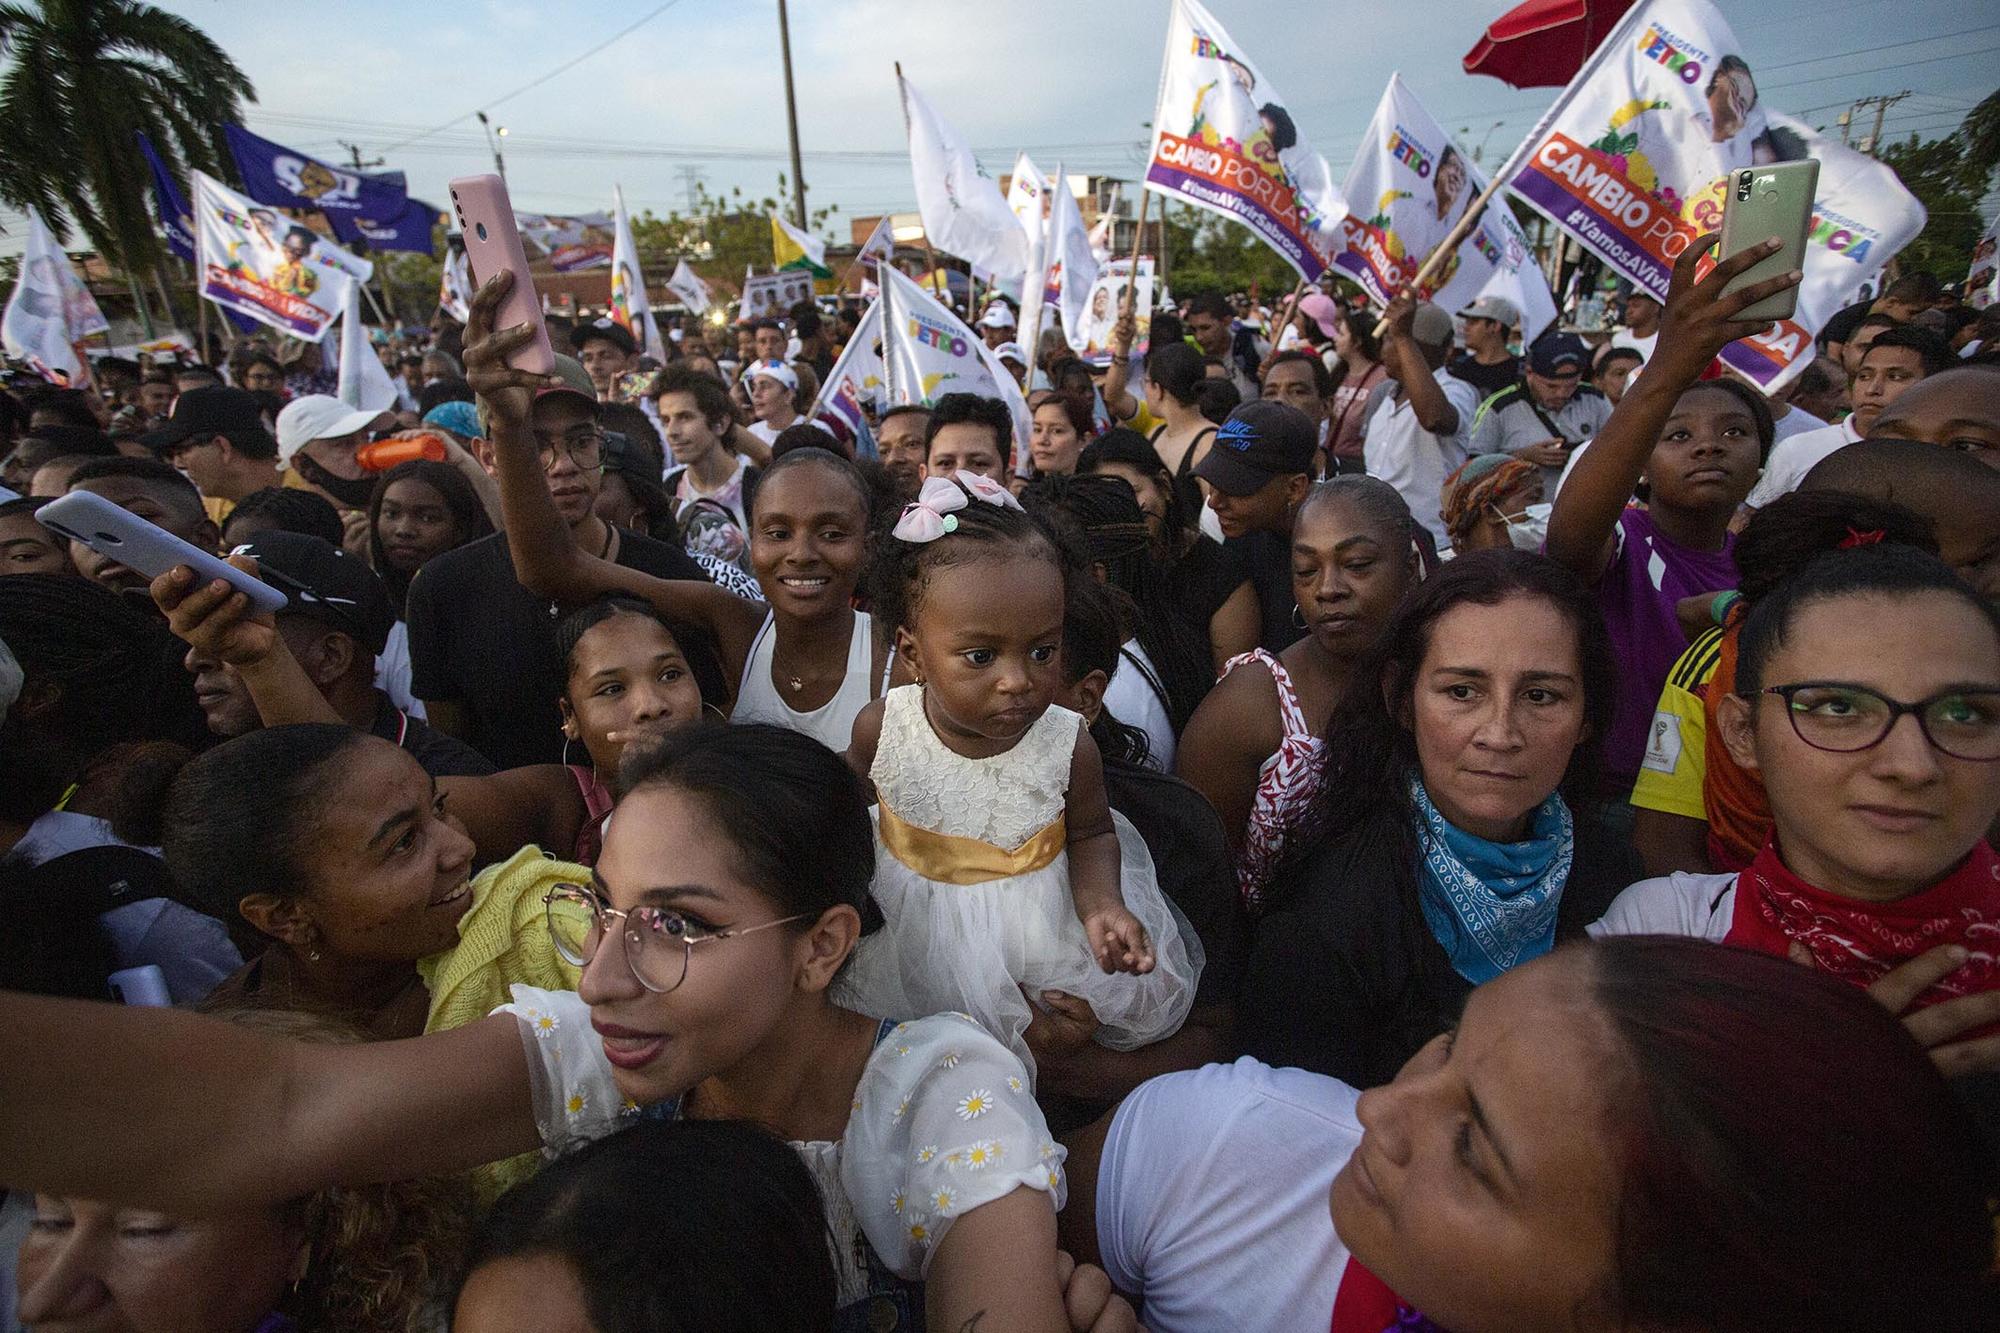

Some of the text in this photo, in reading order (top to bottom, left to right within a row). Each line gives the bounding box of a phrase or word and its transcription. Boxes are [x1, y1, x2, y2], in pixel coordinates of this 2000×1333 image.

[1638, 28, 1702, 84] PETRO
[1158, 139, 1222, 175] CAMBIO
[1386, 132, 1431, 178] PETRO
[1539, 141, 1690, 259] CAMBIO PO
[1343, 220, 1401, 286] CAMBIO
[1566, 209, 1671, 295] #VamosAVivi
[908, 319, 967, 357] PETRO
[1748, 320, 1800, 361] DA
